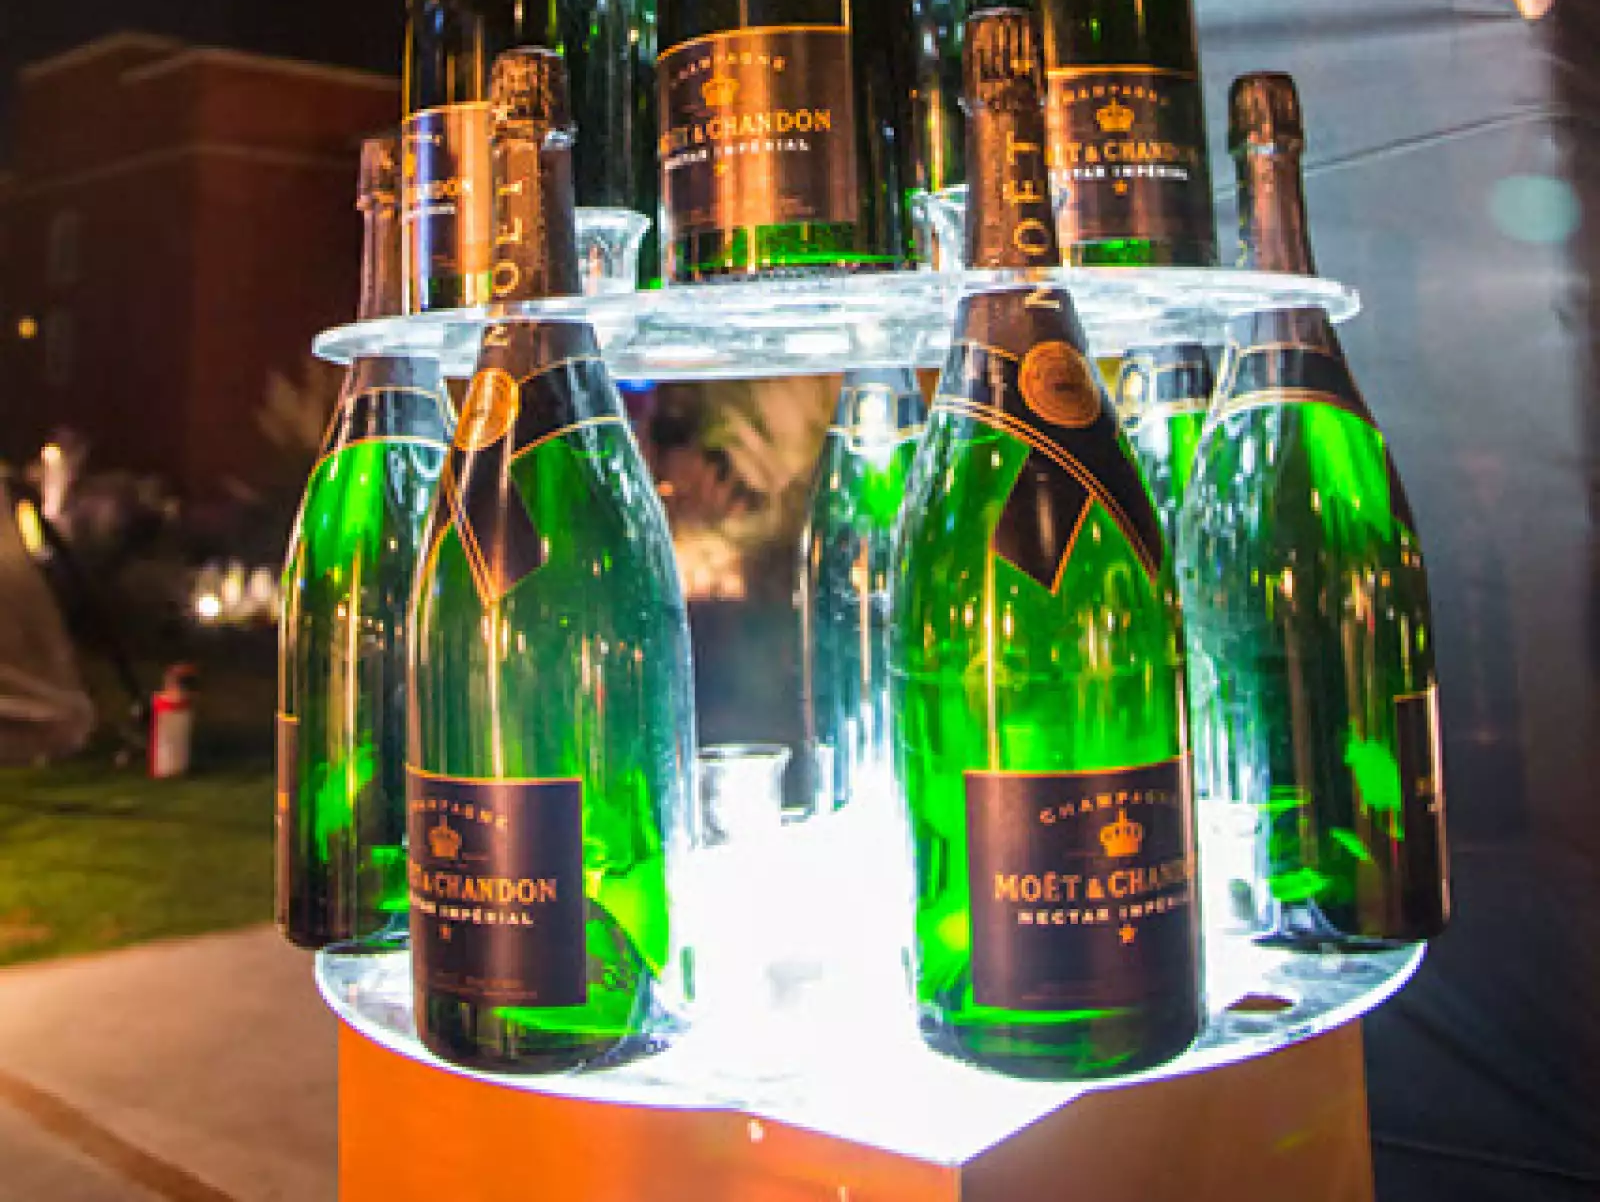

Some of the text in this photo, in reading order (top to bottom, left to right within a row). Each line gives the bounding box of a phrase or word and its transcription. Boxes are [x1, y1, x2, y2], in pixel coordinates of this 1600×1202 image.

[706, 109, 832, 140] CHANDON
[433, 872, 557, 905] CHANDON
[1086, 876, 1105, 900] &
[1017, 907, 1110, 926] NECTAR
